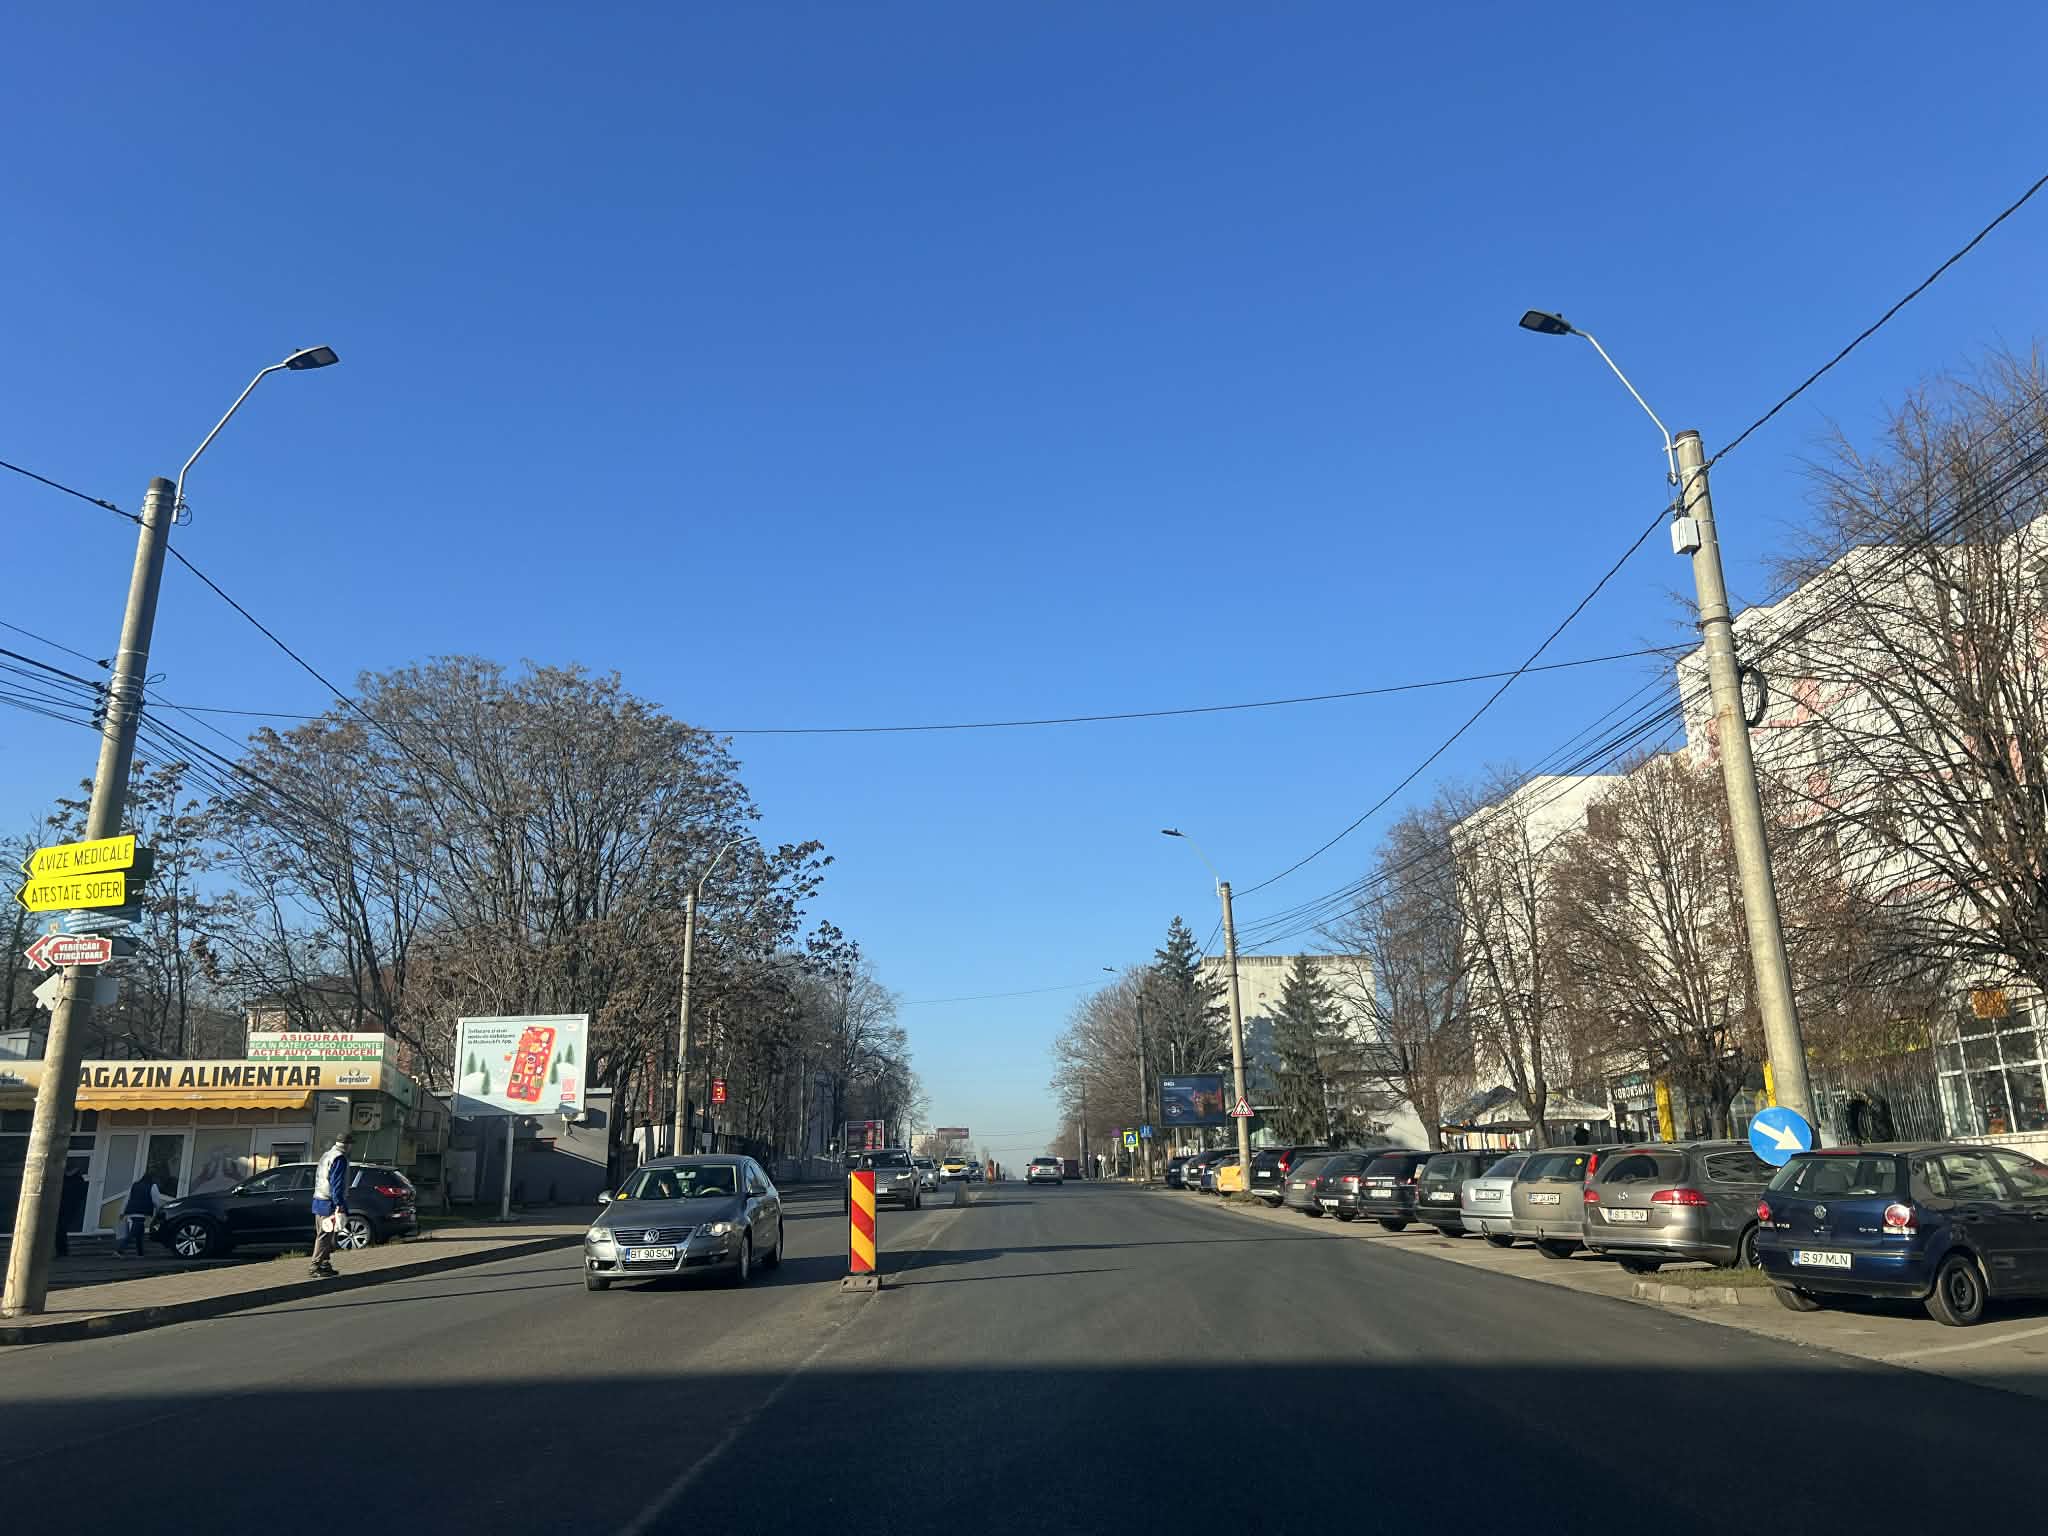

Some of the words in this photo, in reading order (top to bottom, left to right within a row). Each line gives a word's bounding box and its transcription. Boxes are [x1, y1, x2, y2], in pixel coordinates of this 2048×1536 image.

[38, 852, 70, 871] AVIZE
[74, 842, 132, 866] MEDICALE
[32, 884, 82, 904] ATESTATE
[86, 880, 122, 899] SOFERI
[80, 1066, 173, 1088] AGAZIN
[178, 1065, 321, 1087] ALIMENTAR
[630, 1249, 641, 1259] BT
[643, 1249, 655, 1259] 90
[655, 1248, 673, 1258] SCM
[1812, 1253, 1824, 1264] 97
[1825, 1253, 1848, 1265] MLN
